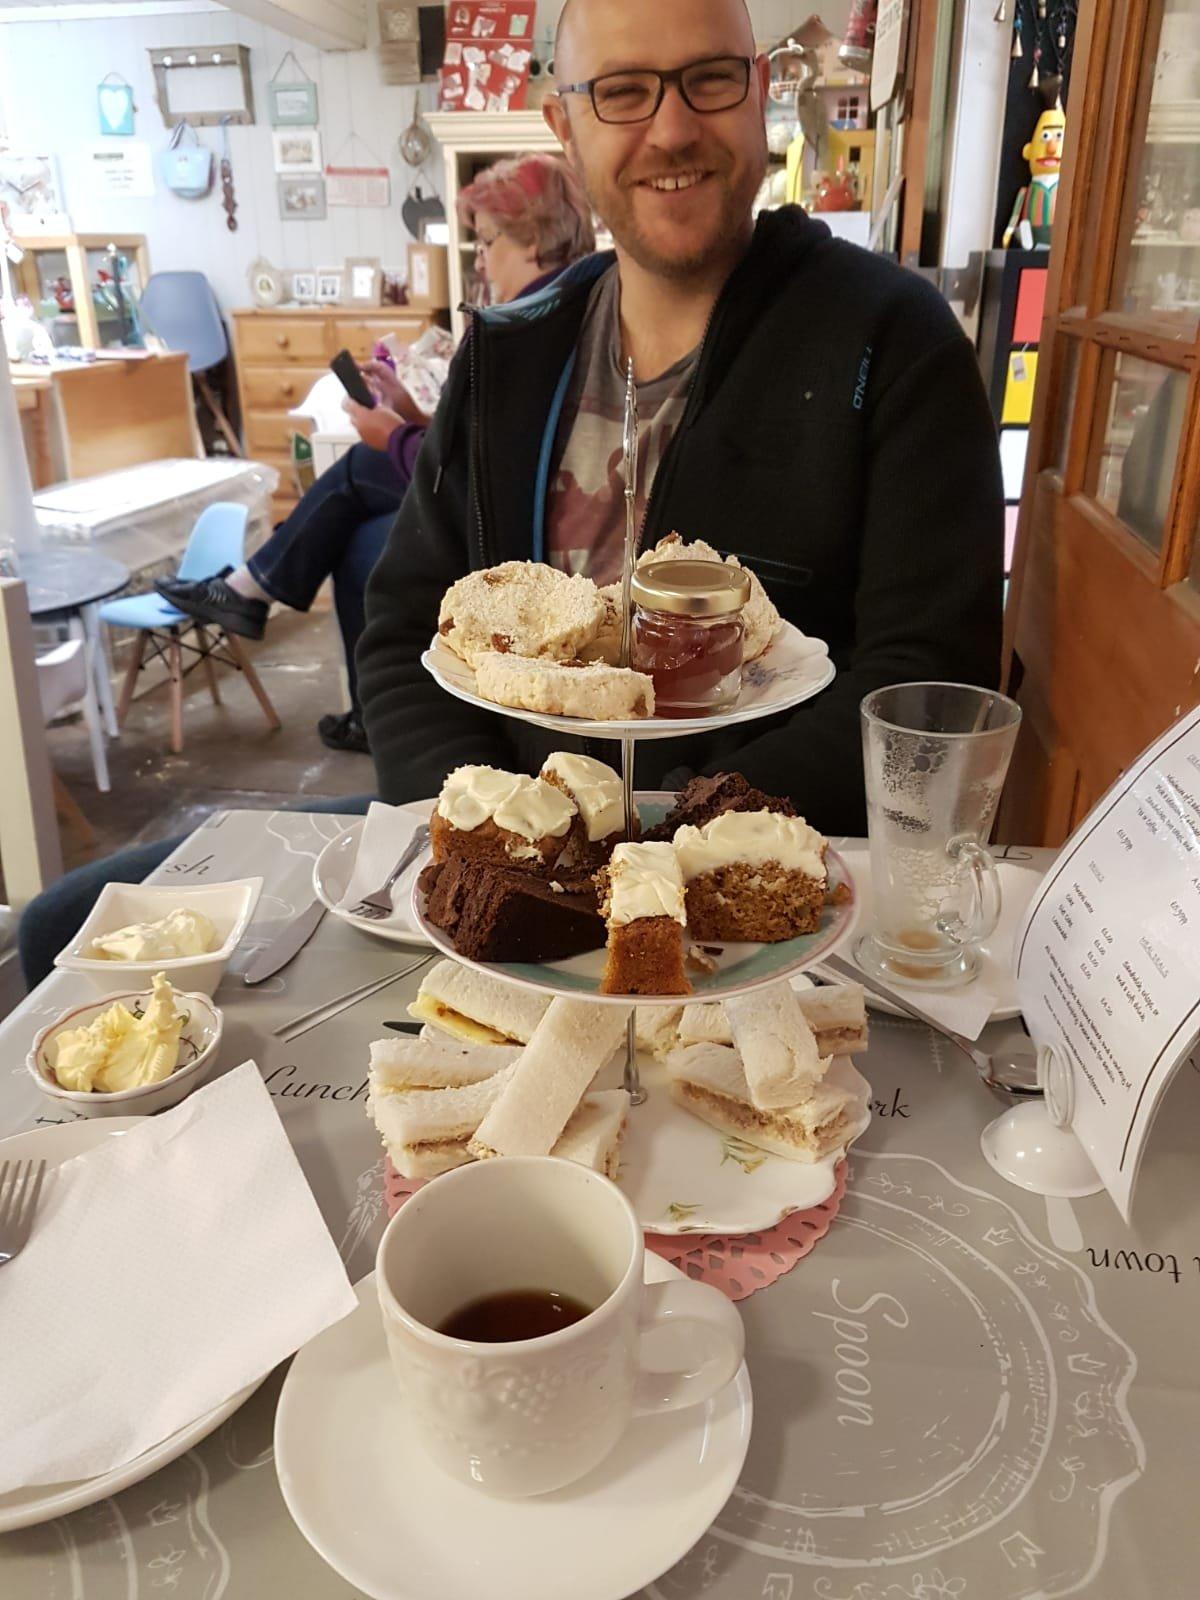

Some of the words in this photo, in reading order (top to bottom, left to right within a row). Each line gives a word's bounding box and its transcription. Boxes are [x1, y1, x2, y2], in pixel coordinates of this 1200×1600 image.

[264, 1064, 371, 1101] Lunch
[1086, 1247, 1183, 1283] town
[811, 1277, 909, 1426] Spoon
